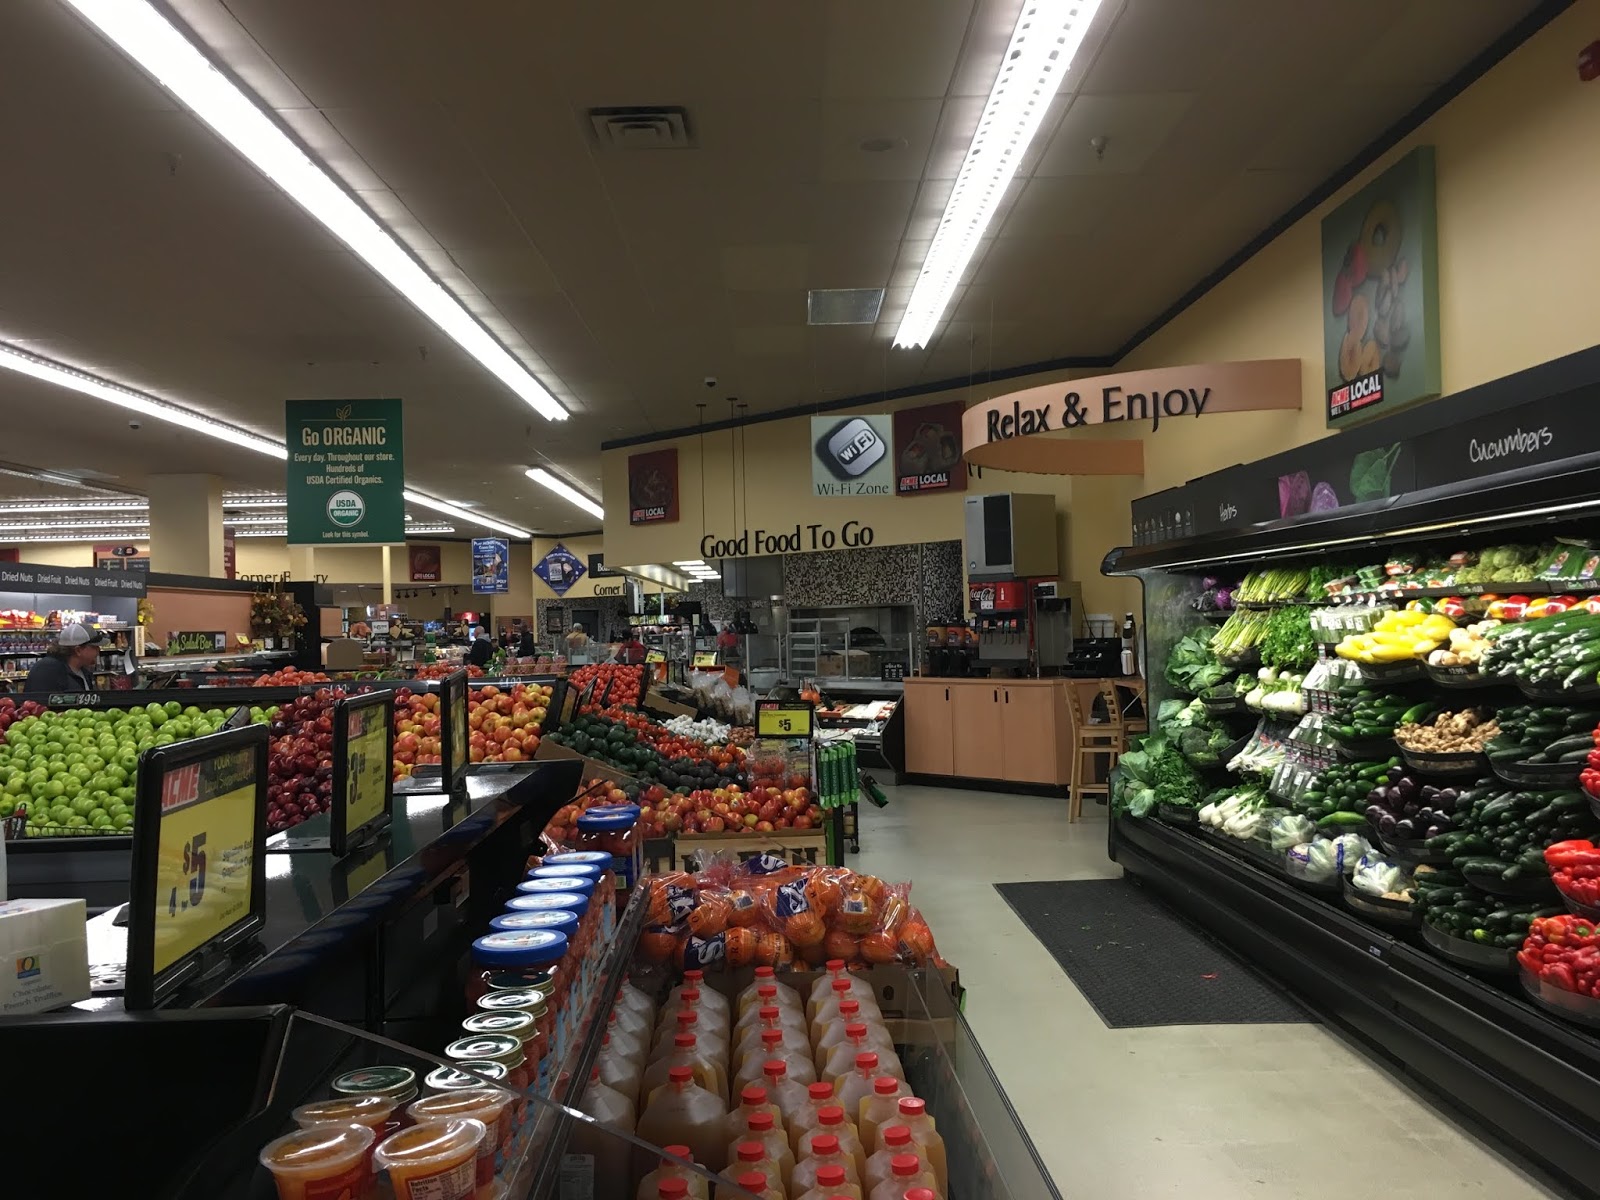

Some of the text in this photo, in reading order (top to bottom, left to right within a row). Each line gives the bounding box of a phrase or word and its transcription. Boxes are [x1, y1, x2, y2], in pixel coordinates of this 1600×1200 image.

[1350, 374, 1381, 401] LOCAL
[987, 386, 1211, 443] Relax & Enjoy
[302, 427, 386, 446] Go ORGANIC
[1469, 425, 1553, 463] Cucumbers
[294, 453, 312, 463] Every
[313, 453, 325, 463] day.
[327, 453, 363, 463] Throughout
[376, 452, 395, 461] store.
[326, 464, 364, 473] Hundreds of
[306, 475, 384, 485] USDA Certified Organics.
[919, 473, 948, 485] LOCAL
[817, 483, 889, 495] Wi-Fi Zone
[336, 499, 356, 507] USDA
[645, 507, 665, 517] LOCAL
[1219, 504, 1238, 522] Herbs
[700, 521, 874, 558] Good Food To Go
[117, 547, 123, 555] 2
[1, 571, 34, 583] Dried Nuts
[37, 573, 62, 584] Dried Fruit
[65, 575, 90, 586] Dried Nuts
[94, 577, 118, 588] Dried Fruit
[121, 579, 143, 589] Dried Nuts
[594, 584, 621, 596] Corner
[180, 633, 213, 650] Salad Bar
[778, 719, 791, 731] $5
[161, 763, 199, 808] ACME
[410, 1176, 438, 1188] Nutrition
